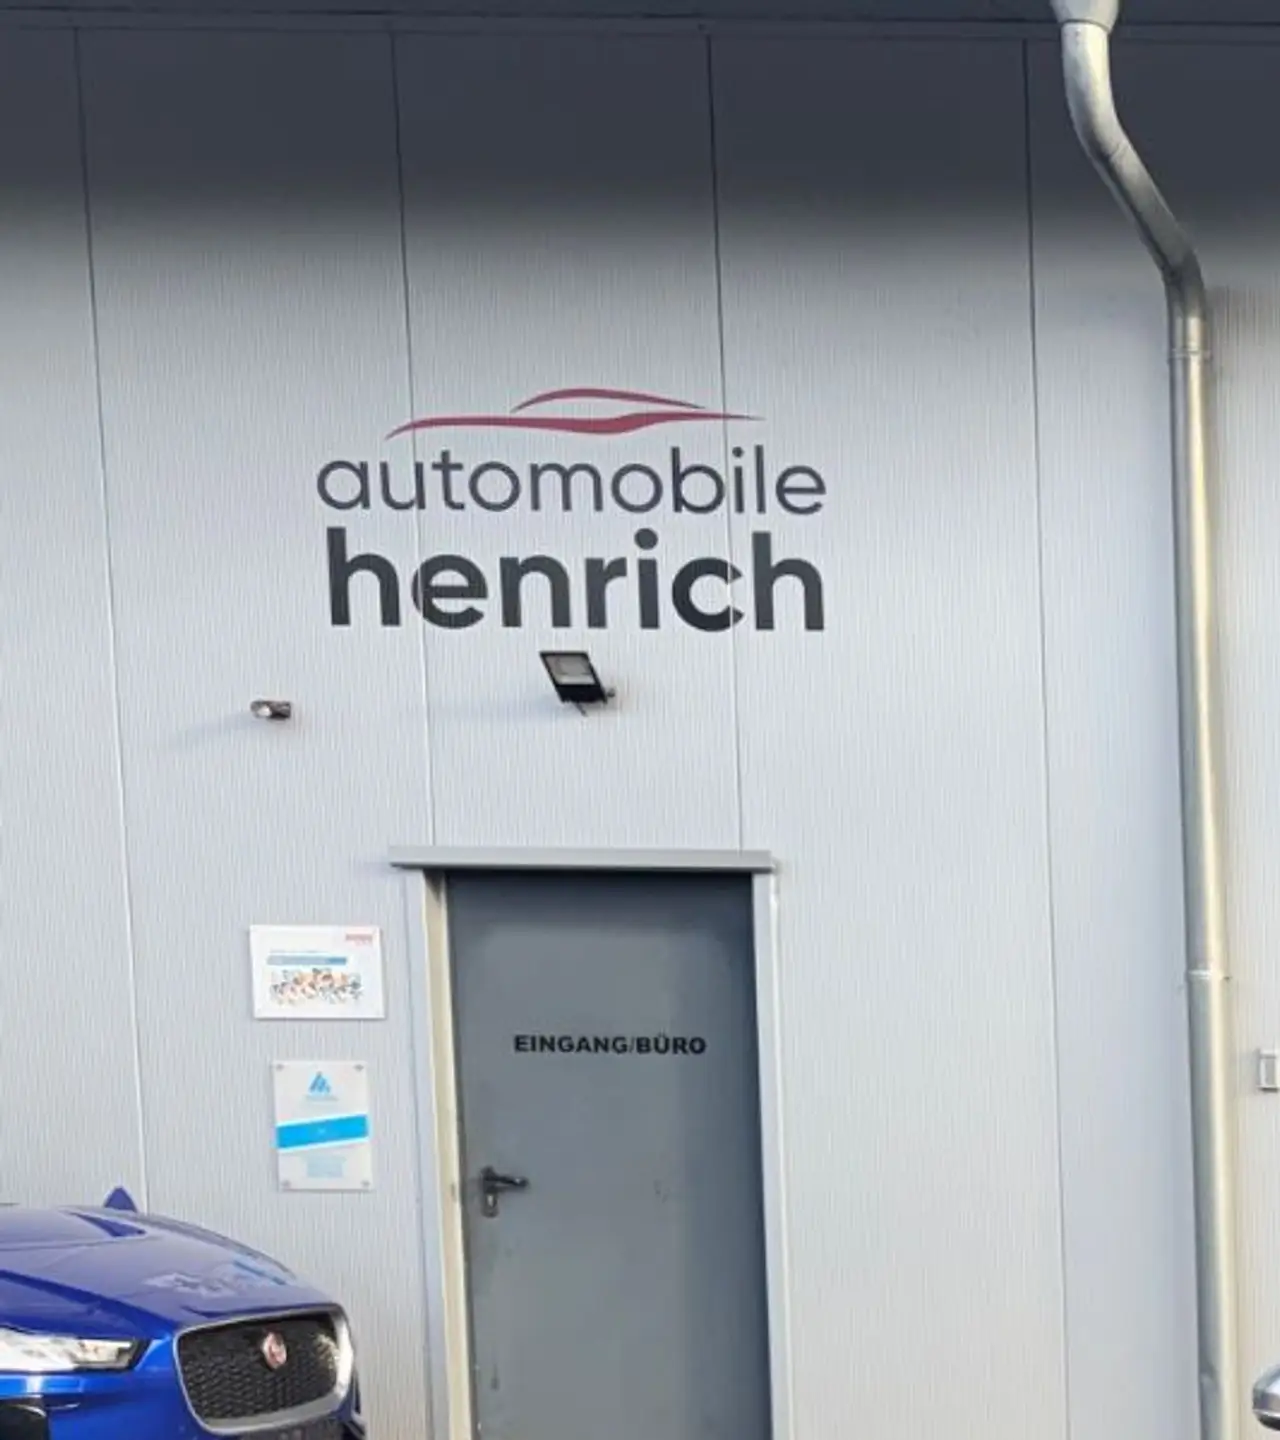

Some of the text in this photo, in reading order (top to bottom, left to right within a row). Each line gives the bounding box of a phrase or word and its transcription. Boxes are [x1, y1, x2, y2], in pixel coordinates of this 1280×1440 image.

[317, 445, 827, 516] automobile
[326, 526, 826, 632] henrich
[513, 1031, 707, 1055] EINGANG/BÜRO
